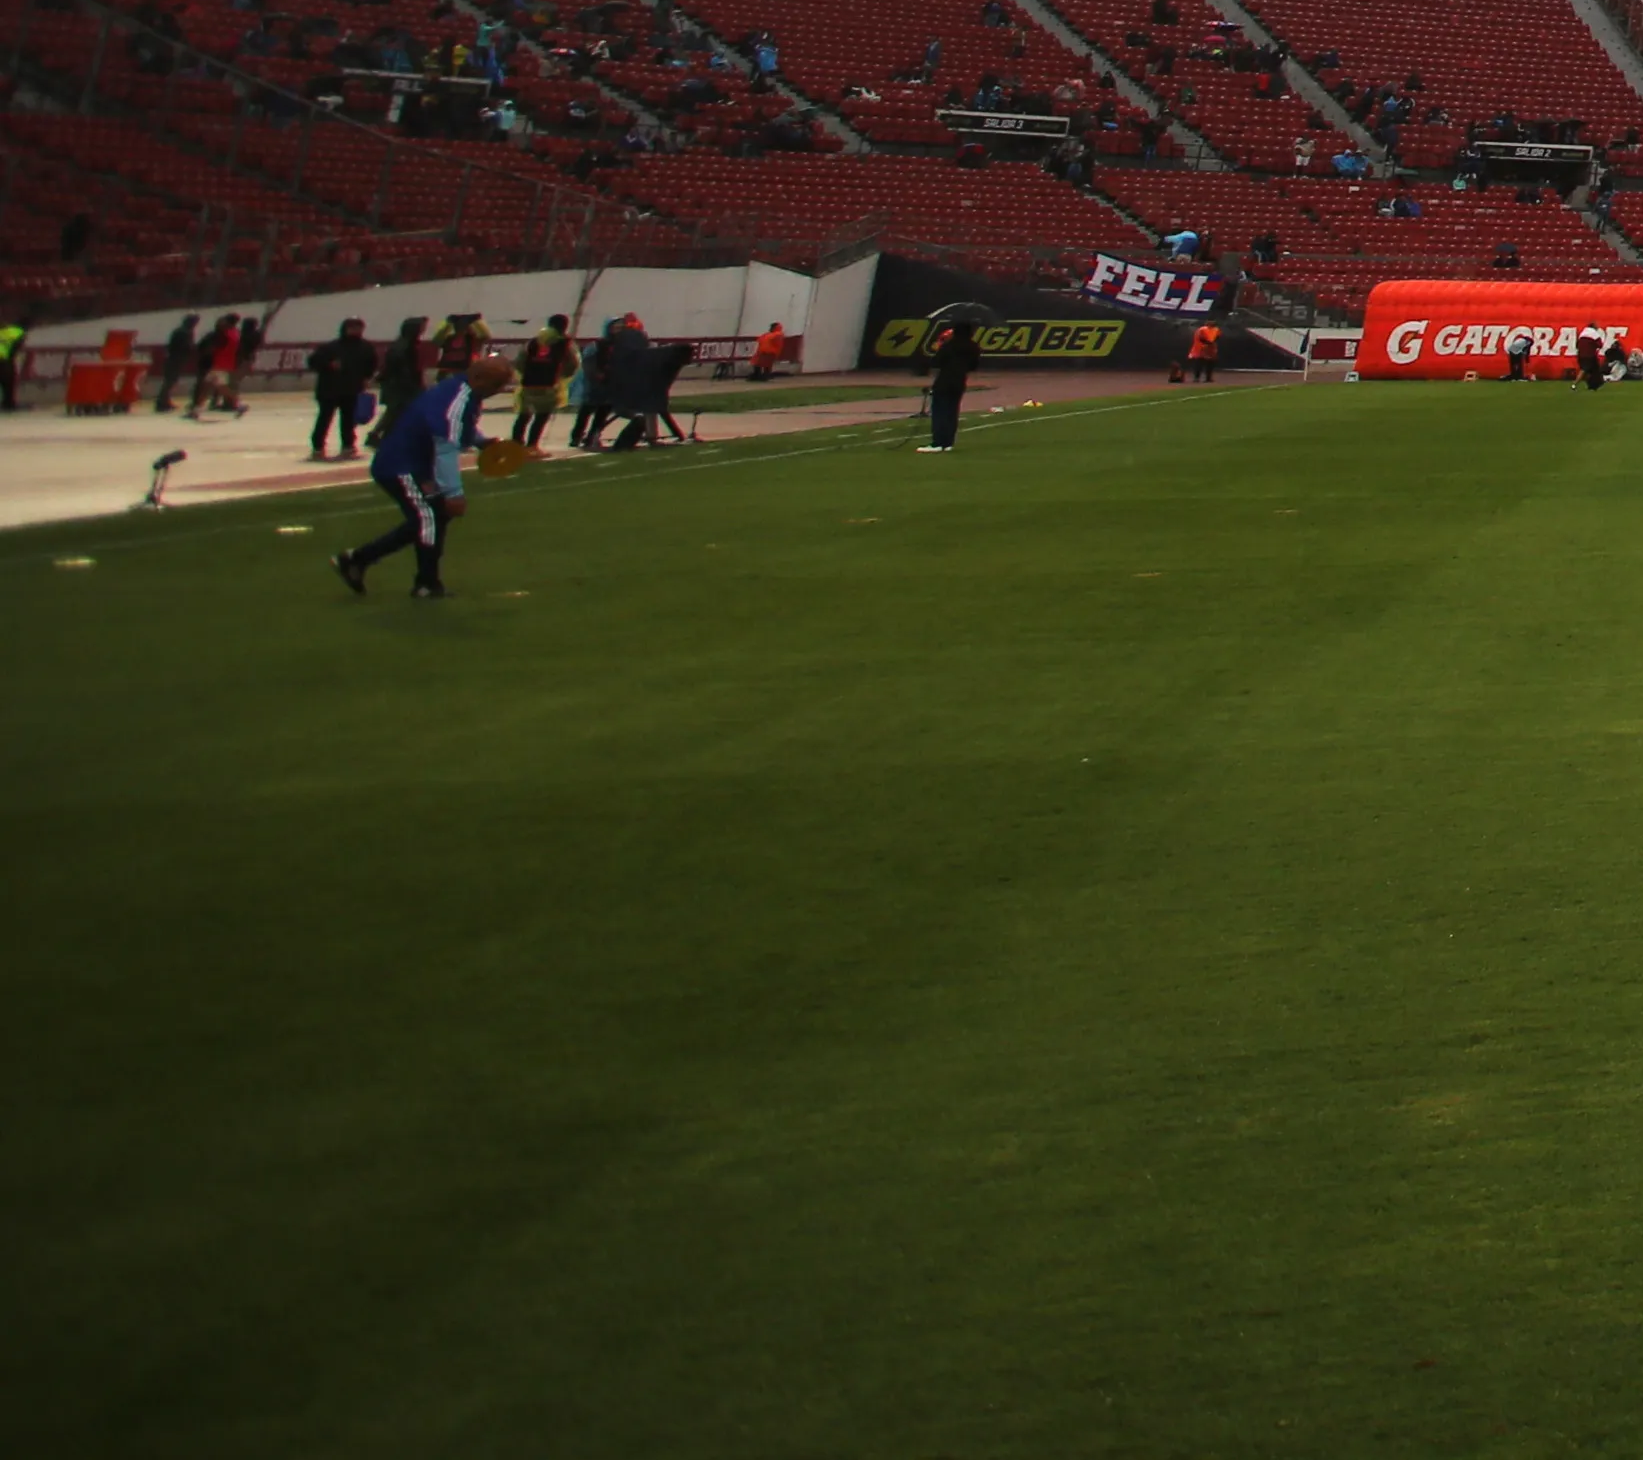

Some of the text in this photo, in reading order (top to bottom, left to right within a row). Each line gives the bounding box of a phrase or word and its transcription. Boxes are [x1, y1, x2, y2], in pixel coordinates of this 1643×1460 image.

[983, 118, 1024, 129] SALIDA 3
[1515, 147, 1552, 157] SALIDA 2
[1086, 253, 1217, 312] FELL
[1041, 327, 1121, 351] BET
[1433, 325, 1629, 357] GATORAE
